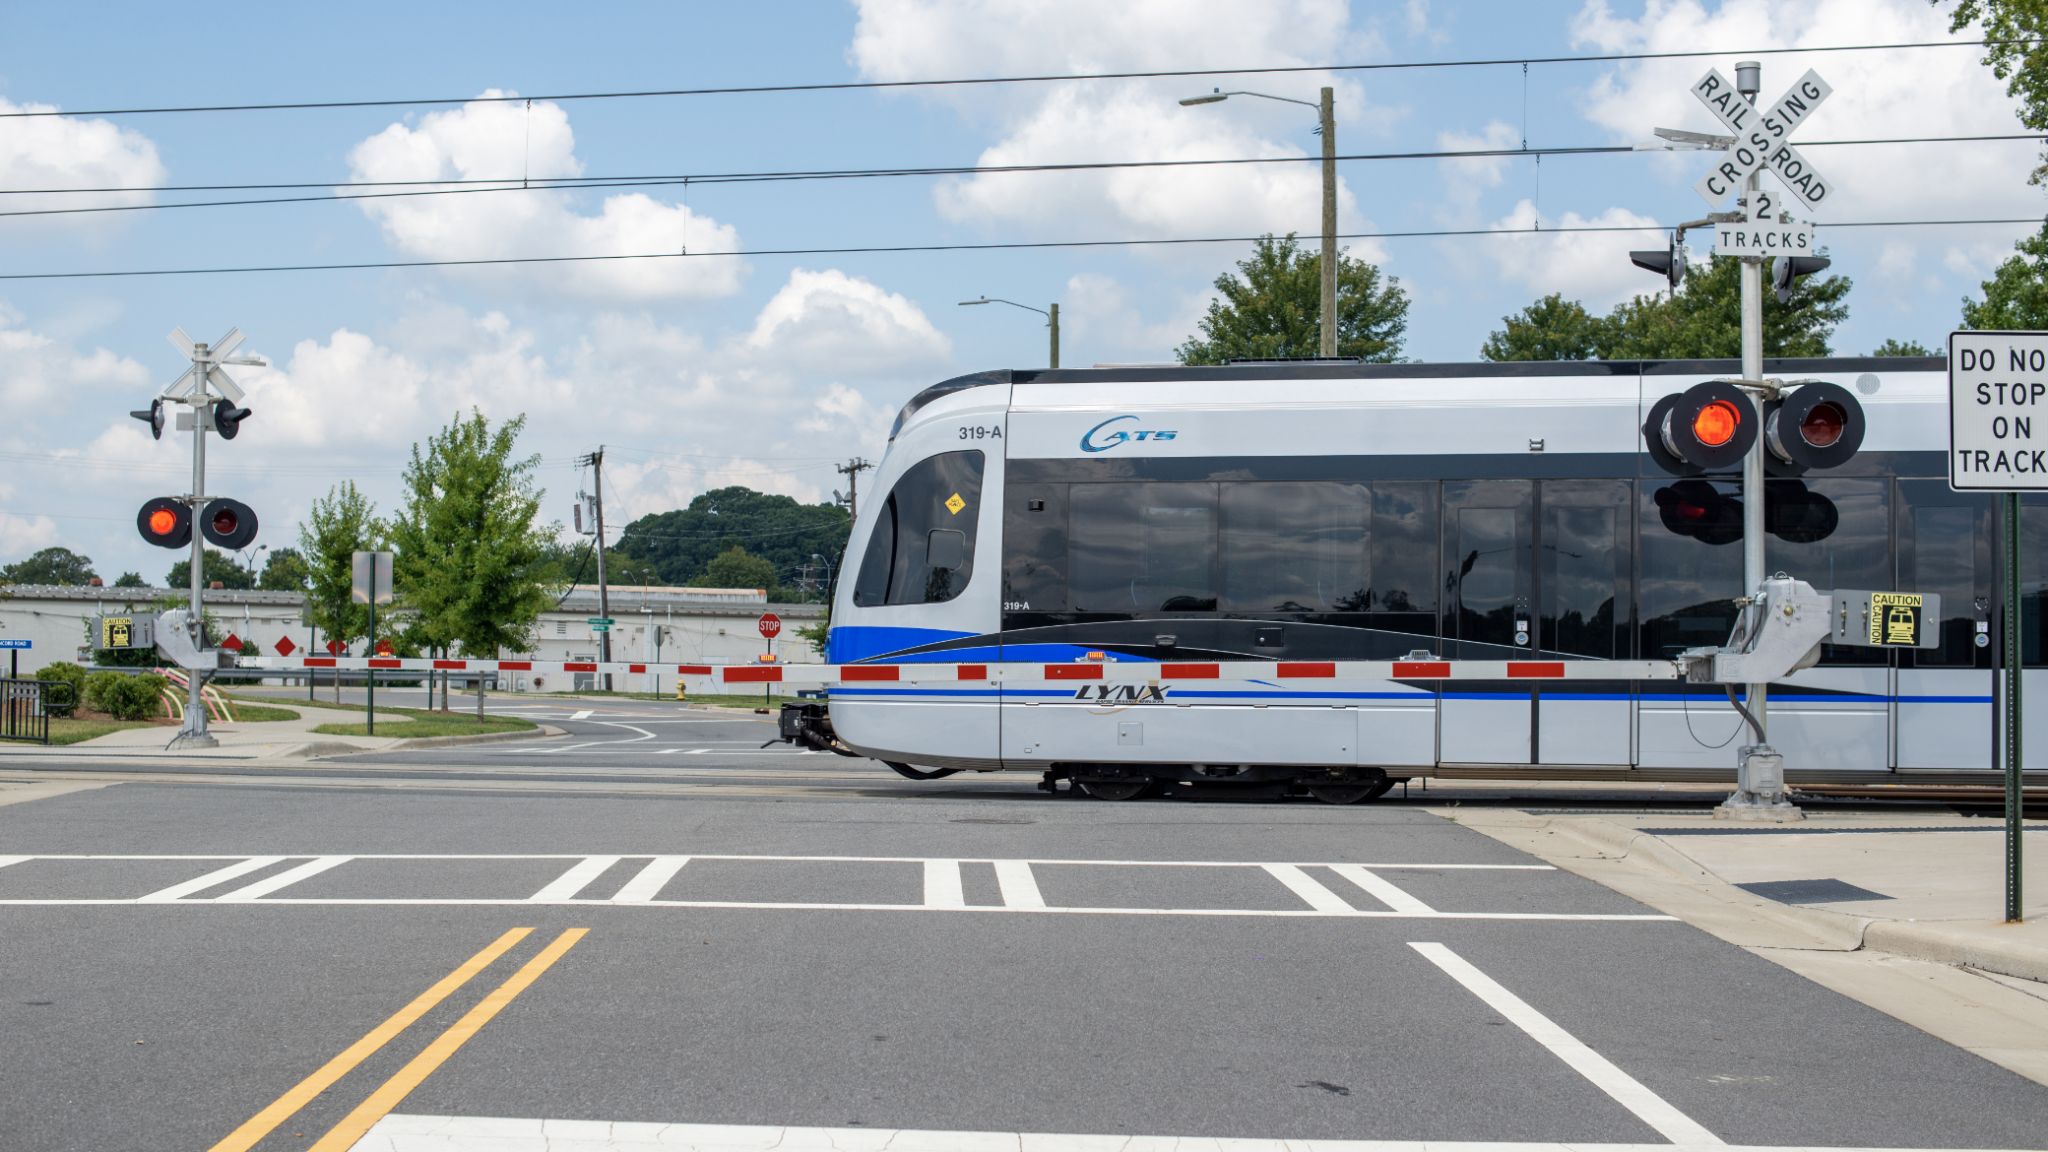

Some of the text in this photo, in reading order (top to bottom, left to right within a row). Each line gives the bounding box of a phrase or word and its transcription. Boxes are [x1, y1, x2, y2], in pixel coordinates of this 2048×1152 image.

[1698, 75, 1826, 202] RAIL ROAD
[1707, 82, 1820, 196] CROSSING
[1756, 197, 1771, 219] 2
[1720, 231, 1807, 248] TRACKS
[1961, 349, 2046, 371] DO NO
[1976, 382, 2046, 405] STOP
[959, 426, 1002, 440] 319-A
[1079, 415, 1179, 453] CATS
[1992, 416, 2031, 439] ON
[1958, 450, 2048, 473] TRACK
[1003, 601, 1030, 610] 319-A
[1872, 594, 1921, 605] CAUTION
[103, 617, 131, 625] CAUTION
[760, 620, 780, 631] STOP
[1871, 605, 1882, 644] CAUTION
[1075, 684, 1172, 700] LYNX
